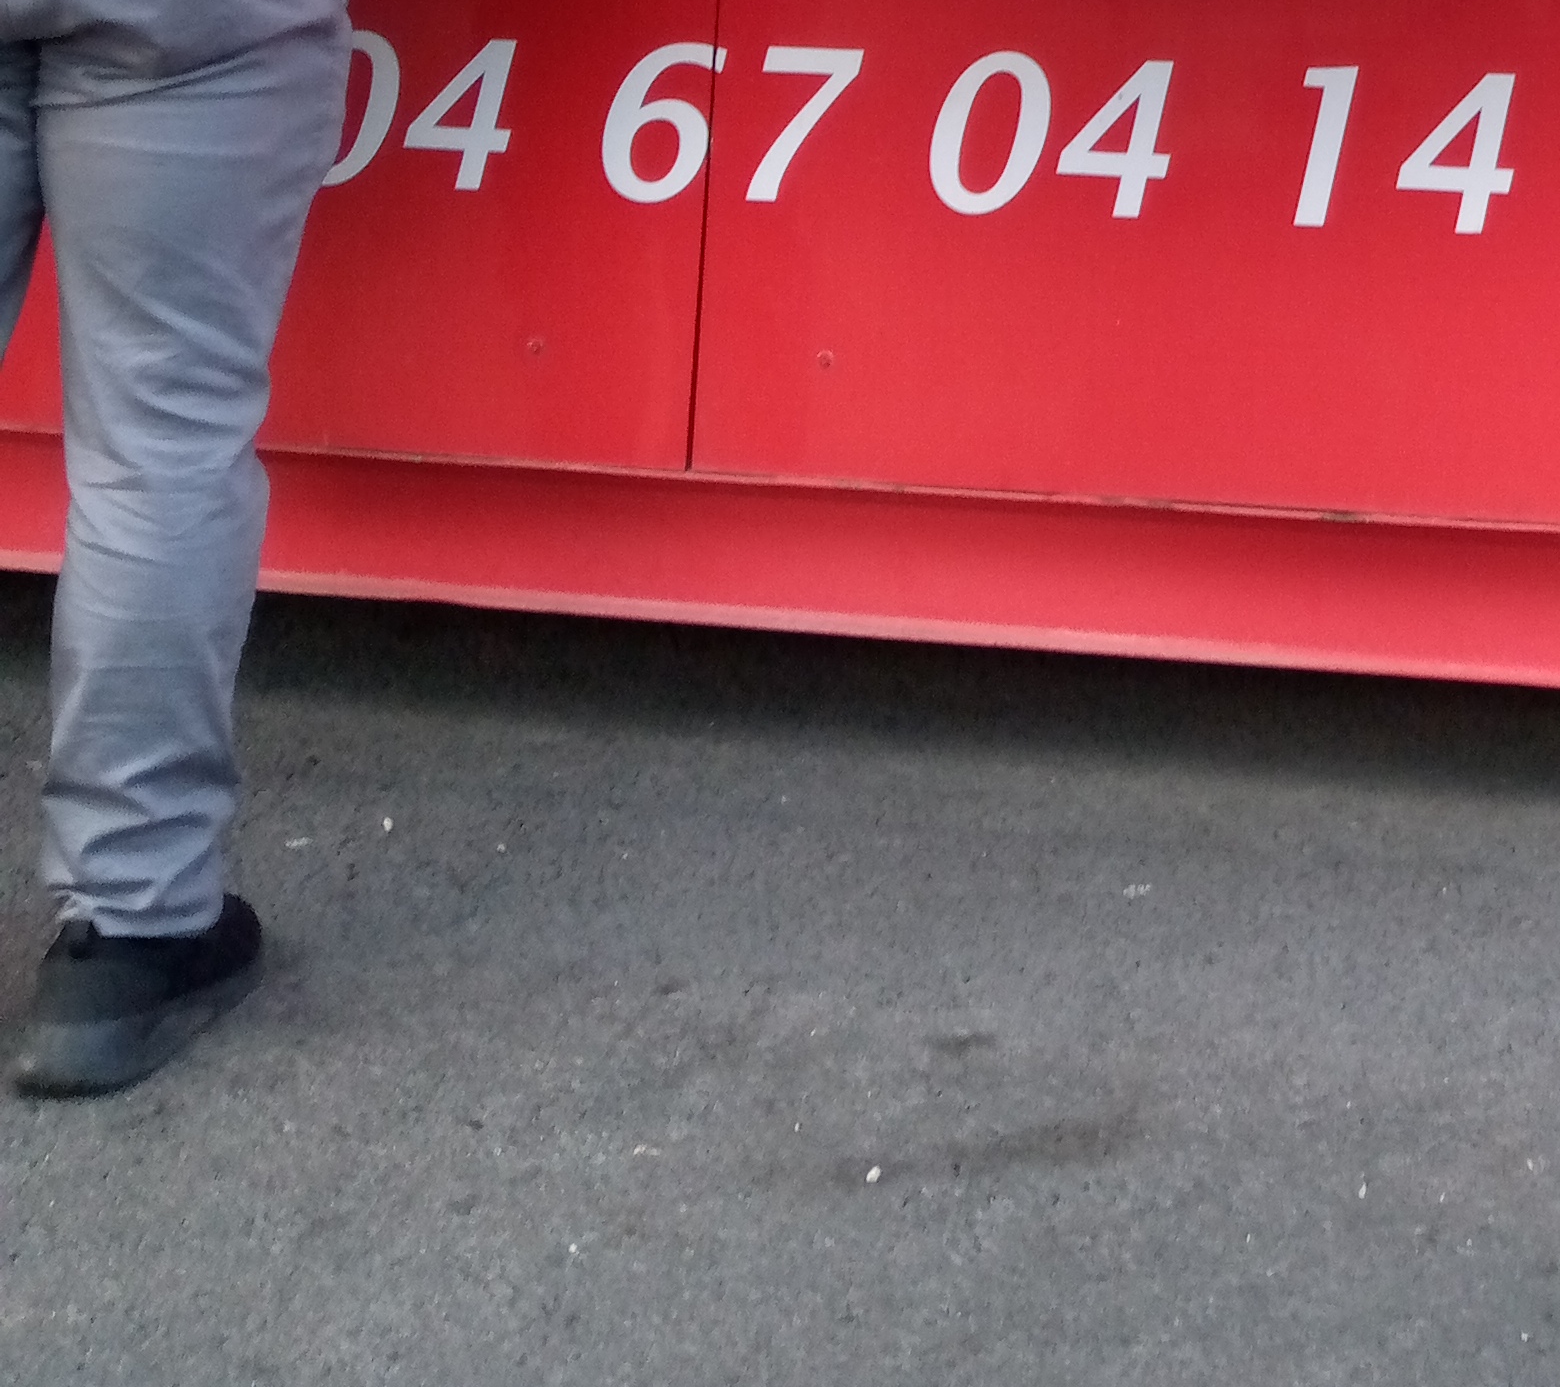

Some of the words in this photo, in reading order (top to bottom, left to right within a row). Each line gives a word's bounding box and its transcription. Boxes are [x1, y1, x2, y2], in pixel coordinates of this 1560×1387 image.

[321, 29, 518, 192] 04
[600, 41, 865, 204] 67
[929, 49, 1175, 219] 04
[1292, 65, 1517, 235] 14
